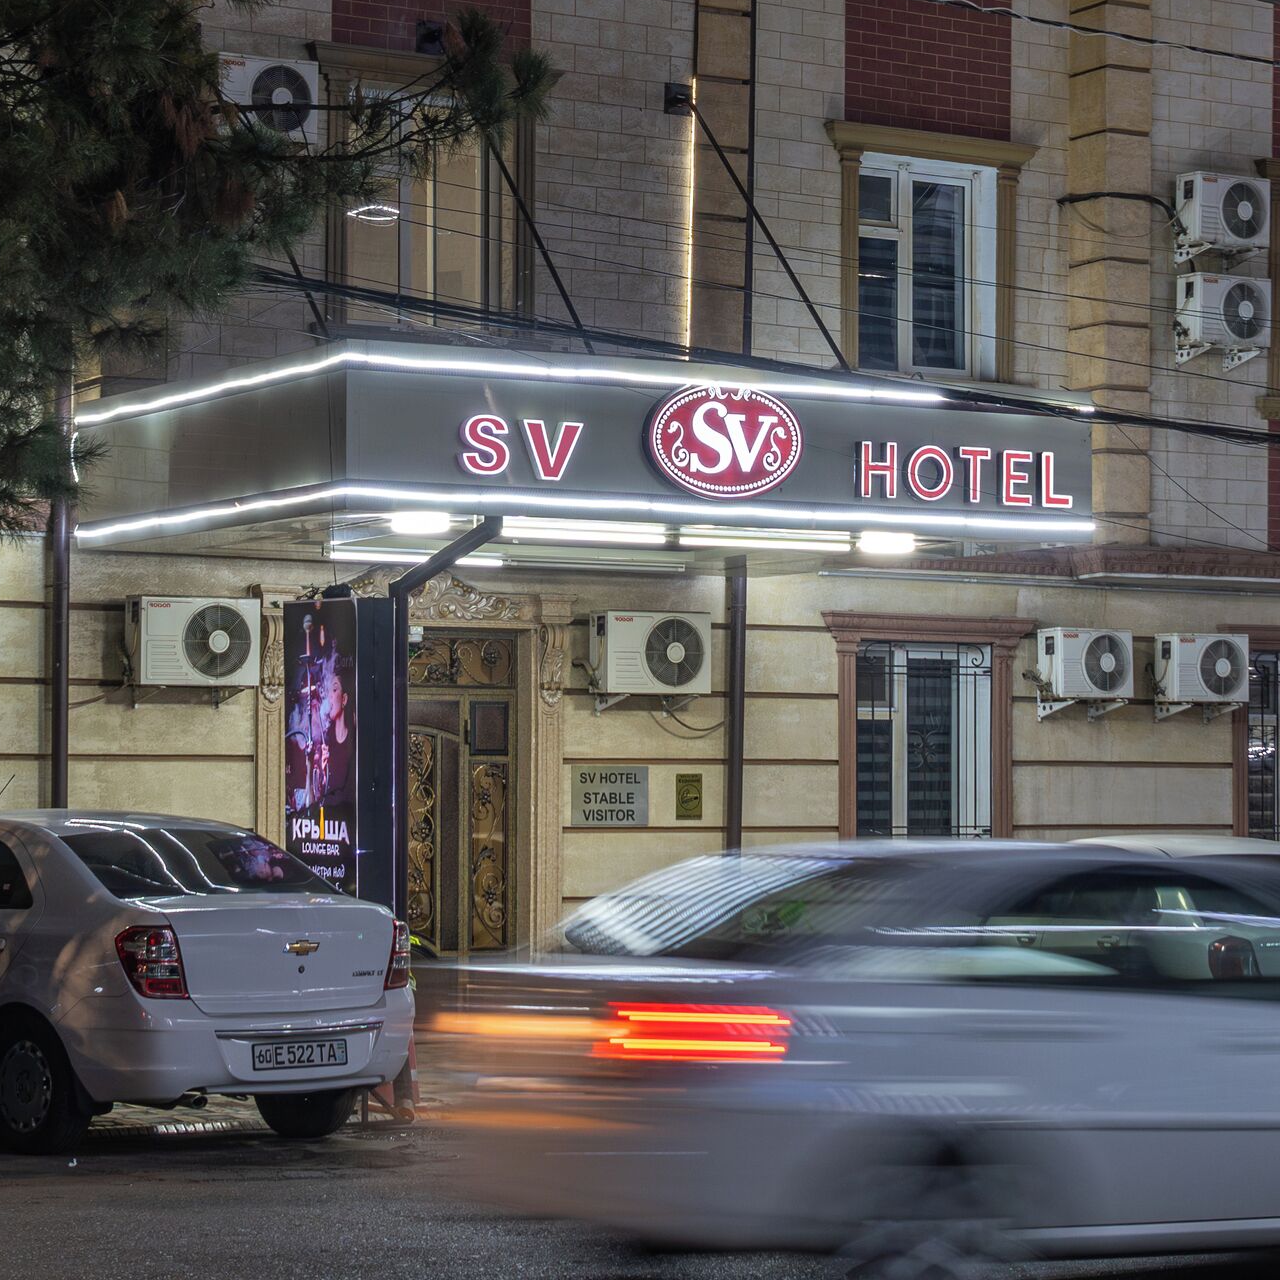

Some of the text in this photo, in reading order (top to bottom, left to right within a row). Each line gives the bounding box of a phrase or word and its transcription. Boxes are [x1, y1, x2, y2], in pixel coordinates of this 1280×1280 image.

[689, 401, 780, 475] SV
[457, 413, 584, 482] SV
[856, 439, 1074, 509] HOTEL
[579, 772, 641, 784] SV HOTEL
[583, 792, 635, 804] STABLE
[582, 809, 636, 821] VISITOR
[292, 815, 350, 845] КРЫША
[302, 842, 340, 856] LOUNGE BAR
[332, 864, 345, 878] над
